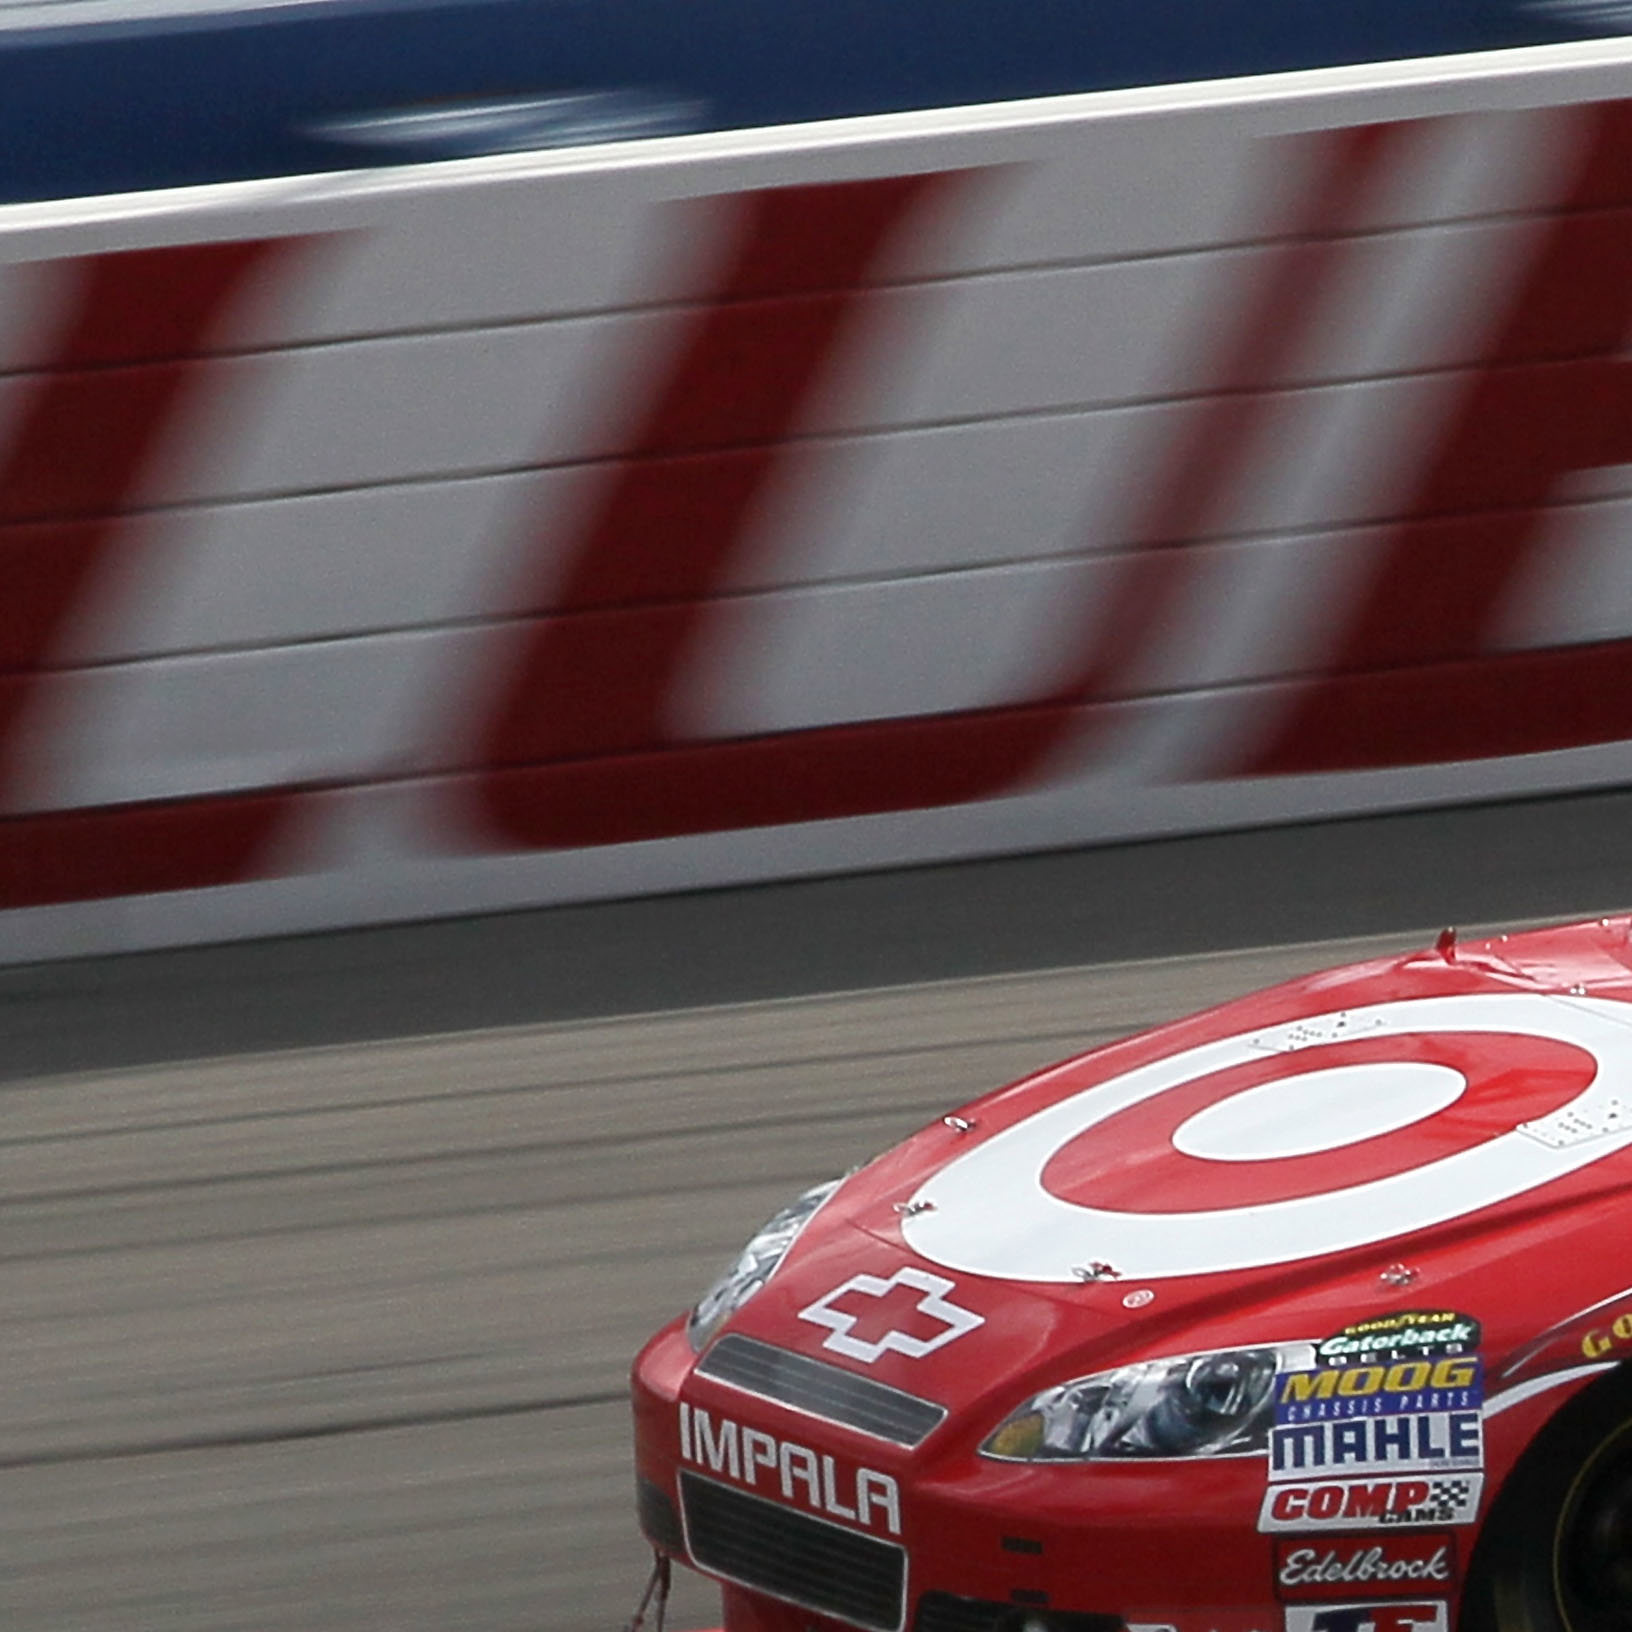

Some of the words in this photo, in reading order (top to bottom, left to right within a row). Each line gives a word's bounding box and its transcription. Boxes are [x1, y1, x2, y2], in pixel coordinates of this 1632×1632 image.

[1319, 1323, 1474, 1356] Gatorback
[1280, 1356, 1479, 1405] MOOG
[1287, 1397, 1383, 1421] CHASSIS
[1399, 1391, 1470, 1411] PARTS
[1272, 1412, 1480, 1471] MAHLE
[679, 1402, 902, 1535] IMPALA
[1271, 1481, 1431, 1521] COMP
[1379, 1507, 1455, 1524] CAMS
[1279, 1546, 1451, 1586] Edelbrock
